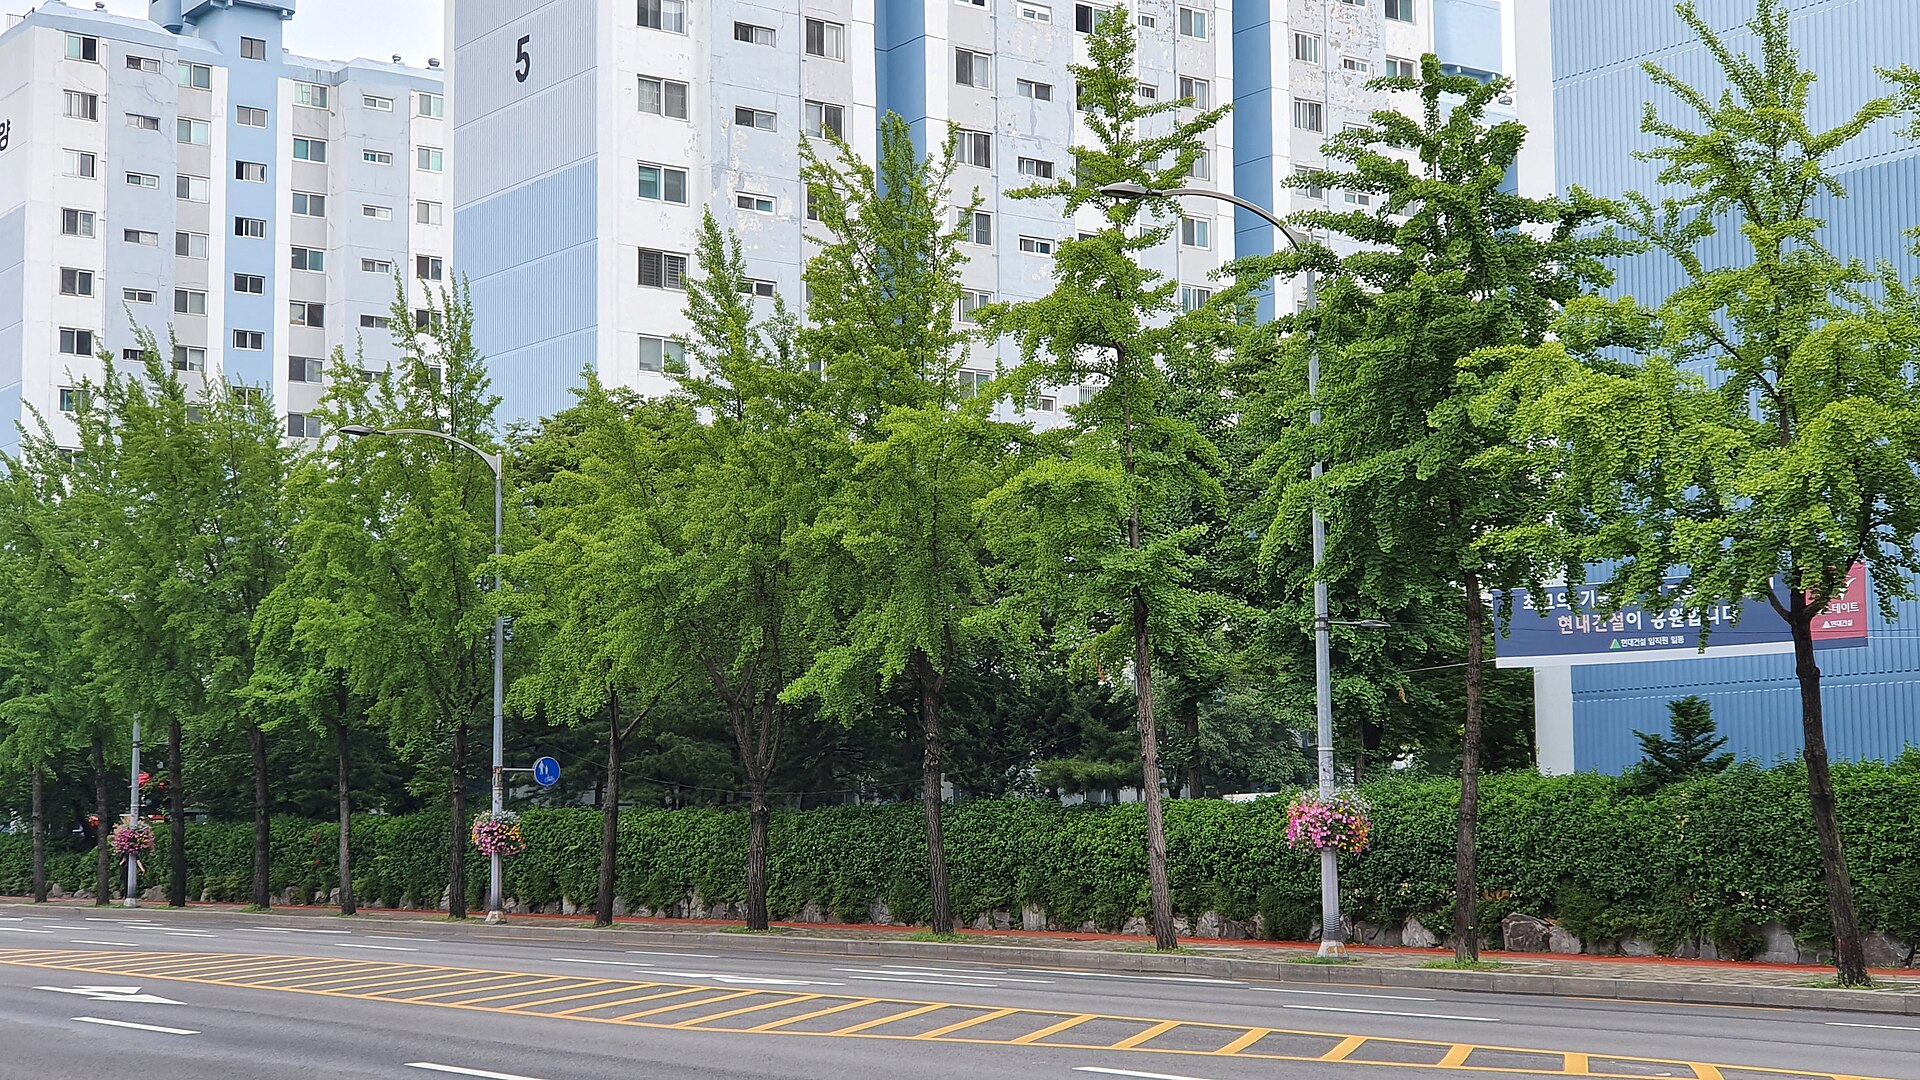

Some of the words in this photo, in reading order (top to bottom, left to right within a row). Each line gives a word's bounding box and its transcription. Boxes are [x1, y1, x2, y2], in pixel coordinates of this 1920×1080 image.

[515, 34, 530, 83] 5
[1558, 611, 1641, 634] 현대건설이
[1621, 637, 1646, 647] 현대건설
[1648, 636, 1669, 646] 임직원
[1671, 635, 1685, 645] 일동
